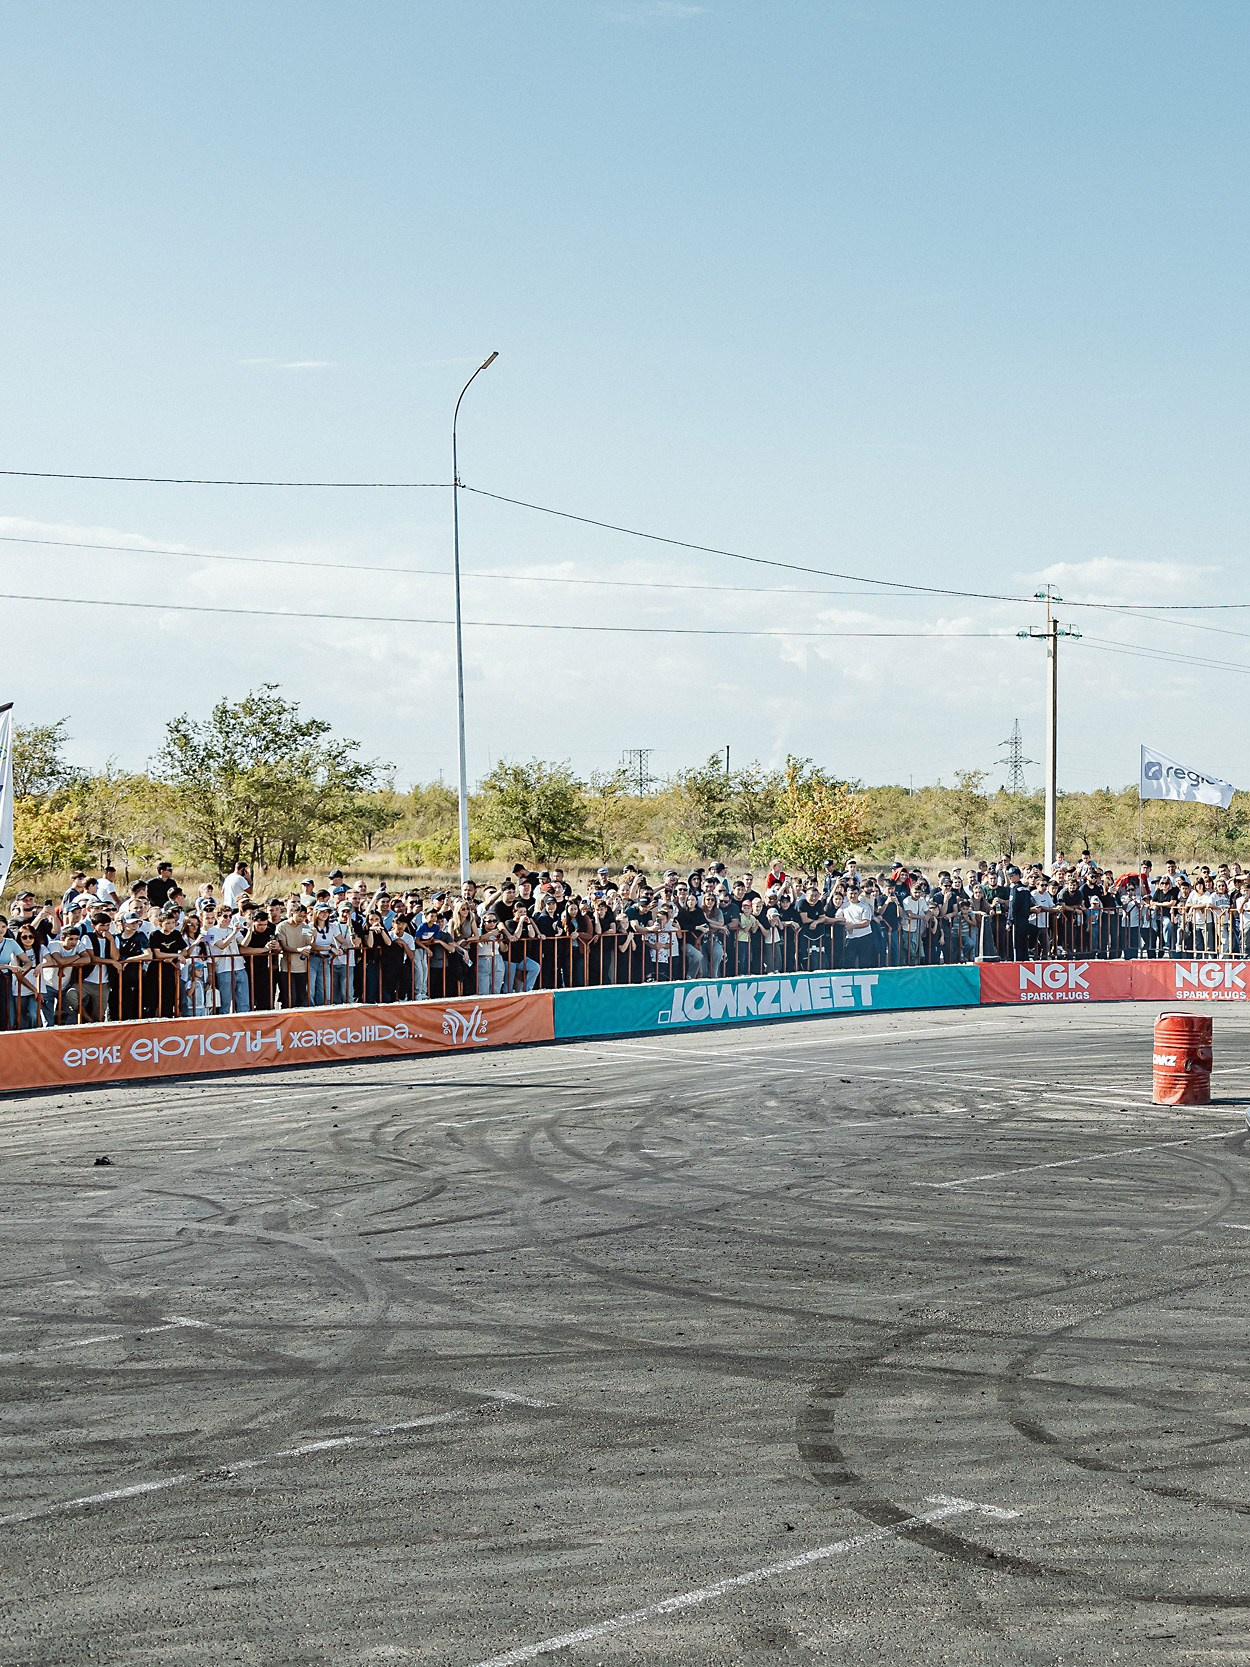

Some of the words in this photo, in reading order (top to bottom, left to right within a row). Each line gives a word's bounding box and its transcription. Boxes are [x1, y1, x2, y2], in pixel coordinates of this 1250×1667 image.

[1019, 963, 1090, 989] NGK
[1175, 962, 1247, 989] NGK
[1020, 992, 1054, 1001] SPARK
[1056, 991, 1090, 1000] PLUGS
[1176, 990, 1209, 999] SPARK
[1211, 991, 1247, 999] PLUGS
